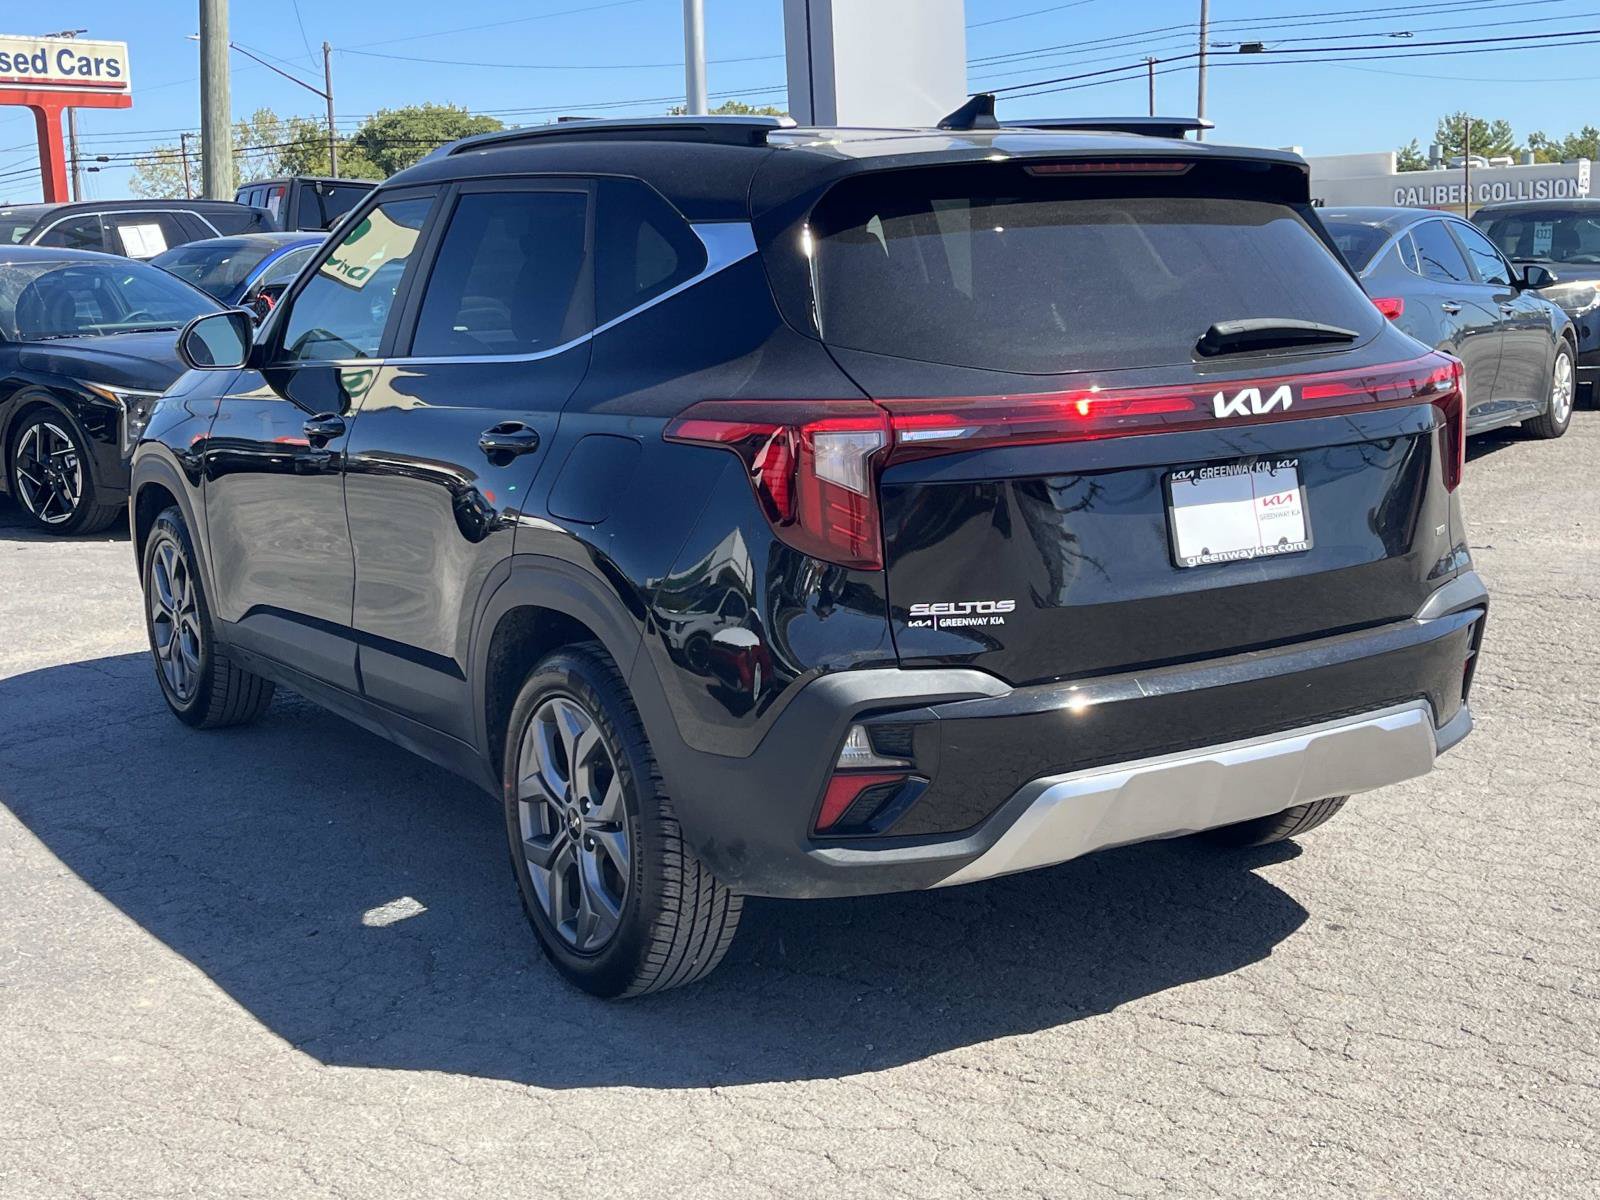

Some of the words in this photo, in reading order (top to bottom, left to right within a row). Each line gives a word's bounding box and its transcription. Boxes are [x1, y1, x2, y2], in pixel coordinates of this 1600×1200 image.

[56, 48, 121, 78] Cars
[1394, 183, 1473, 206] CALIBER
[1478, 178, 1580, 201] COLLISION
[1213, 385, 1292, 418] KIA
[1200, 464, 1254, 479] GREENWAY
[1256, 461, 1271, 473] KIA
[1187, 541, 1307, 568] greenwaykia.com
[909, 600, 1016, 616] SELTOS
[939, 617, 988, 627] GREENWAY
[990, 616, 1005, 625] KIA
